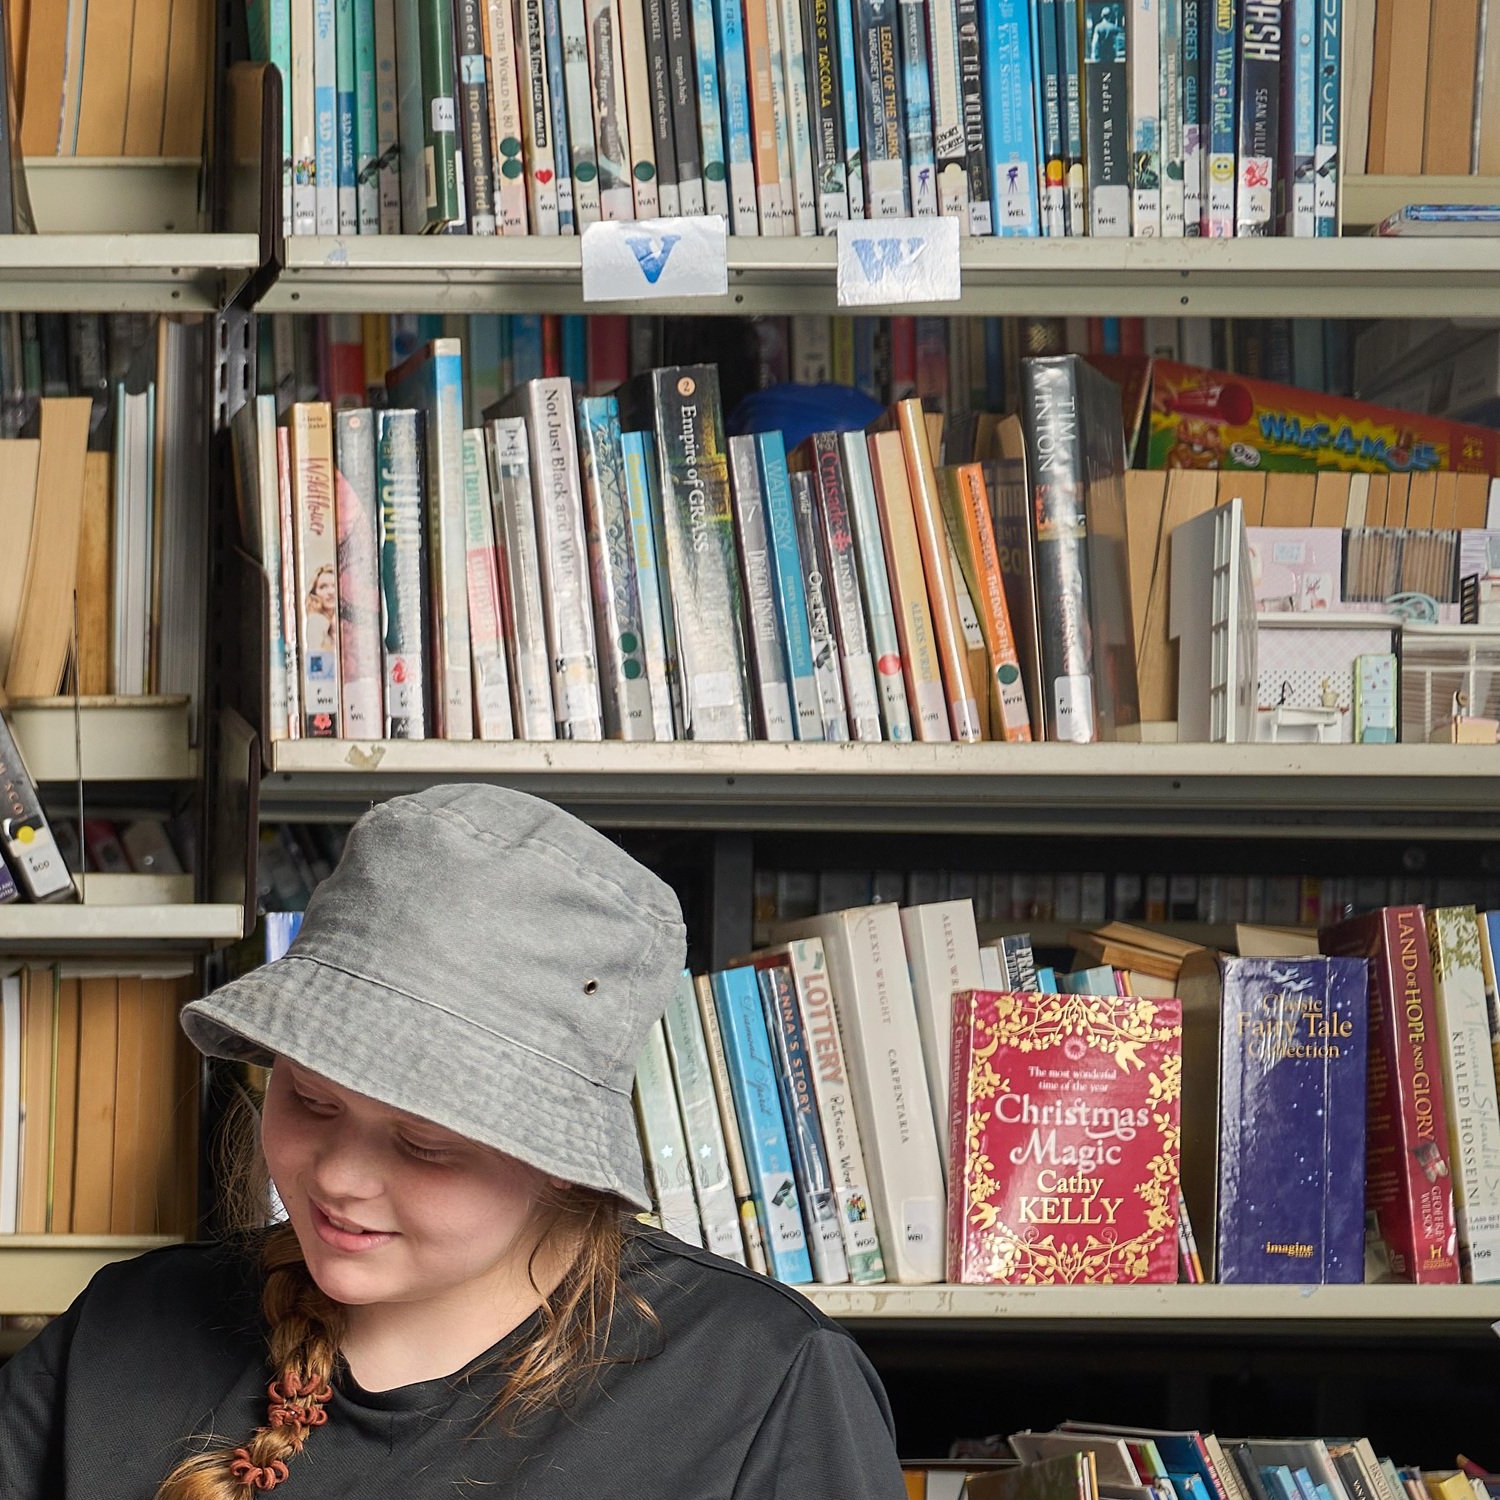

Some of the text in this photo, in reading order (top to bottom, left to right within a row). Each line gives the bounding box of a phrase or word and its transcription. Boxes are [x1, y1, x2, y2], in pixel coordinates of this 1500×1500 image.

[1184, 2, 1198, 61] SECRETS
[961, 53, 984, 153] THE WORLDS
[1101, 71, 1114, 183] Nadia Wheatley
[1254, 88, 1269, 118] SEAN
[467, 89, 491, 211] no-name bird
[625, 235, 682, 285] V
[851, 238, 928, 284] W
[543, 387, 566, 502] Not Just Black
[1054, 396, 1076, 443] TIM
[304, 457, 331, 537] Wildflower
[672, 394, 711, 554] Empire of GRASS
[820, 451, 843, 530] Crusade
[766, 458, 794, 556] WATERSKY
[942, 912, 956, 957] ALEXIS
[1396, 911, 1416, 968] LAND
[865, 918, 892, 1025] ALEXIS WRIGHT
[802, 971, 846, 1087] LOTTERY
[1235, 1012, 1353, 1043] Fairy Tale
[1262, 993, 1324, 1015] Classic
[1405, 989, 1427, 1046] HOPE
[779, 983, 814, 1115] ANNA'S STORY
[1028, 1065, 1118, 1081] The most wonderful
[1247, 1041, 1341, 1060] Collection
[886, 1048, 911, 1146] CARPENTARIA
[1038, 1079, 1110, 1094] time of the year
[1412, 1072, 1436, 1141] GLORY
[994, 1092, 1150, 1142] Christmas
[1451, 1030, 1480, 1210] KHALED HOSSEINI
[1009, 1127, 1122, 1174] Magic
[1018, 1196, 1124, 1225] KELLY
[1037, 1168, 1104, 1200] Cathy
[1265, 1241, 1314, 1256] imagine
